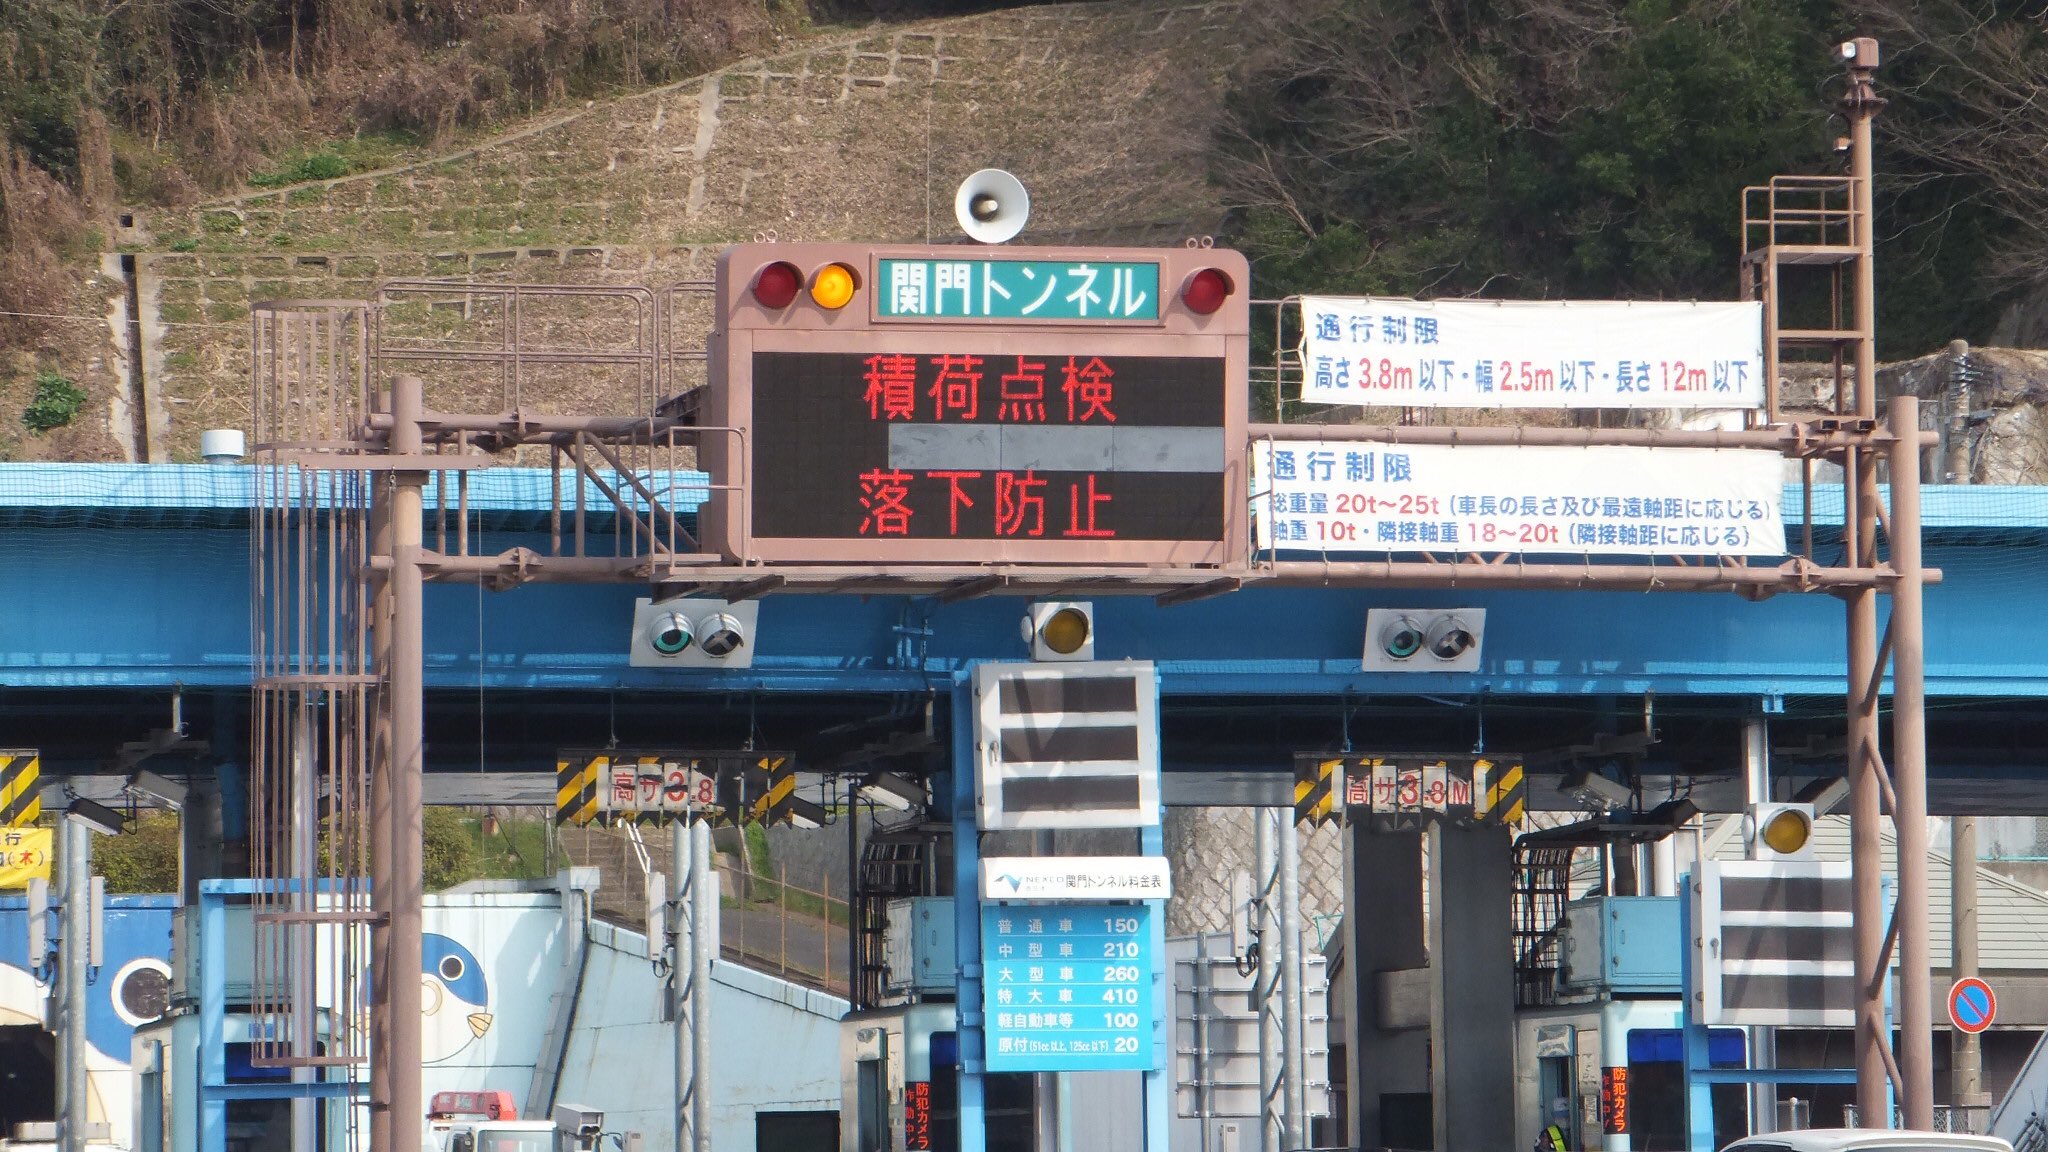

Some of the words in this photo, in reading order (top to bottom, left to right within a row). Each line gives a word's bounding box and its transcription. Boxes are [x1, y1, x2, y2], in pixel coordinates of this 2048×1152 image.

[891, 262, 1147, 317] 関門トンネル
[1315, 312, 1440, 345] 通行制限
[862, 353, 1119, 423] 積荷点検
[1266, 450, 1413, 482] 通行制限
[858, 469, 1117, 538] 落下防止
[1065, 874, 1162, 889] 関門トンネル料金表
[1104, 918, 1139, 933] 150
[1103, 943, 1139, 958] 210
[1104, 966, 1139, 982] 260
[1102, 988, 1139, 1004] 410
[1104, 1013, 1139, 1028] 100
[1114, 1037, 1139, 1053] 20
[1612, 1067, 1627, 1132] 防犯カメラ
[915, 1082, 930, 1149] 防犯カメラ
